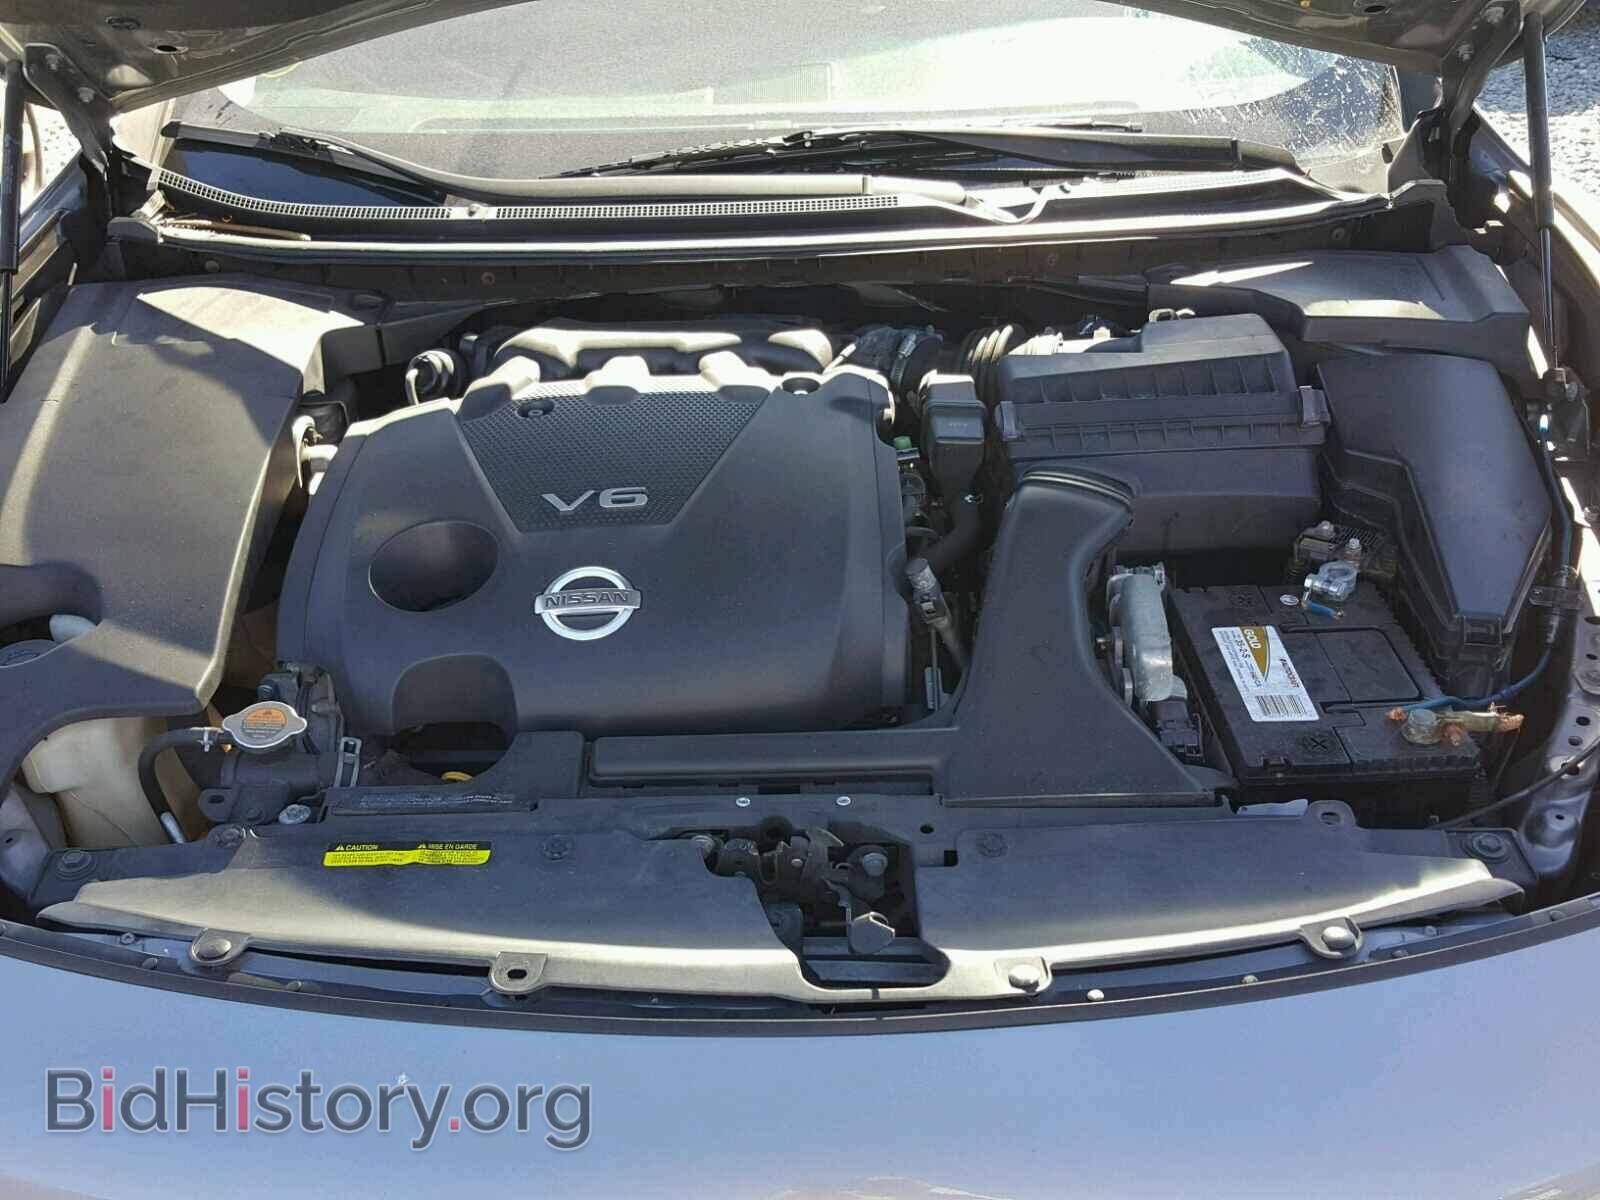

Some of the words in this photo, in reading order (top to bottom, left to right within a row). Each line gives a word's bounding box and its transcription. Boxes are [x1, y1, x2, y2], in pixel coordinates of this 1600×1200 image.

[541, 486, 648, 512] V6
[545, 591, 629, 608] NISSAN
[1244, 628, 1262, 649] GOLD
